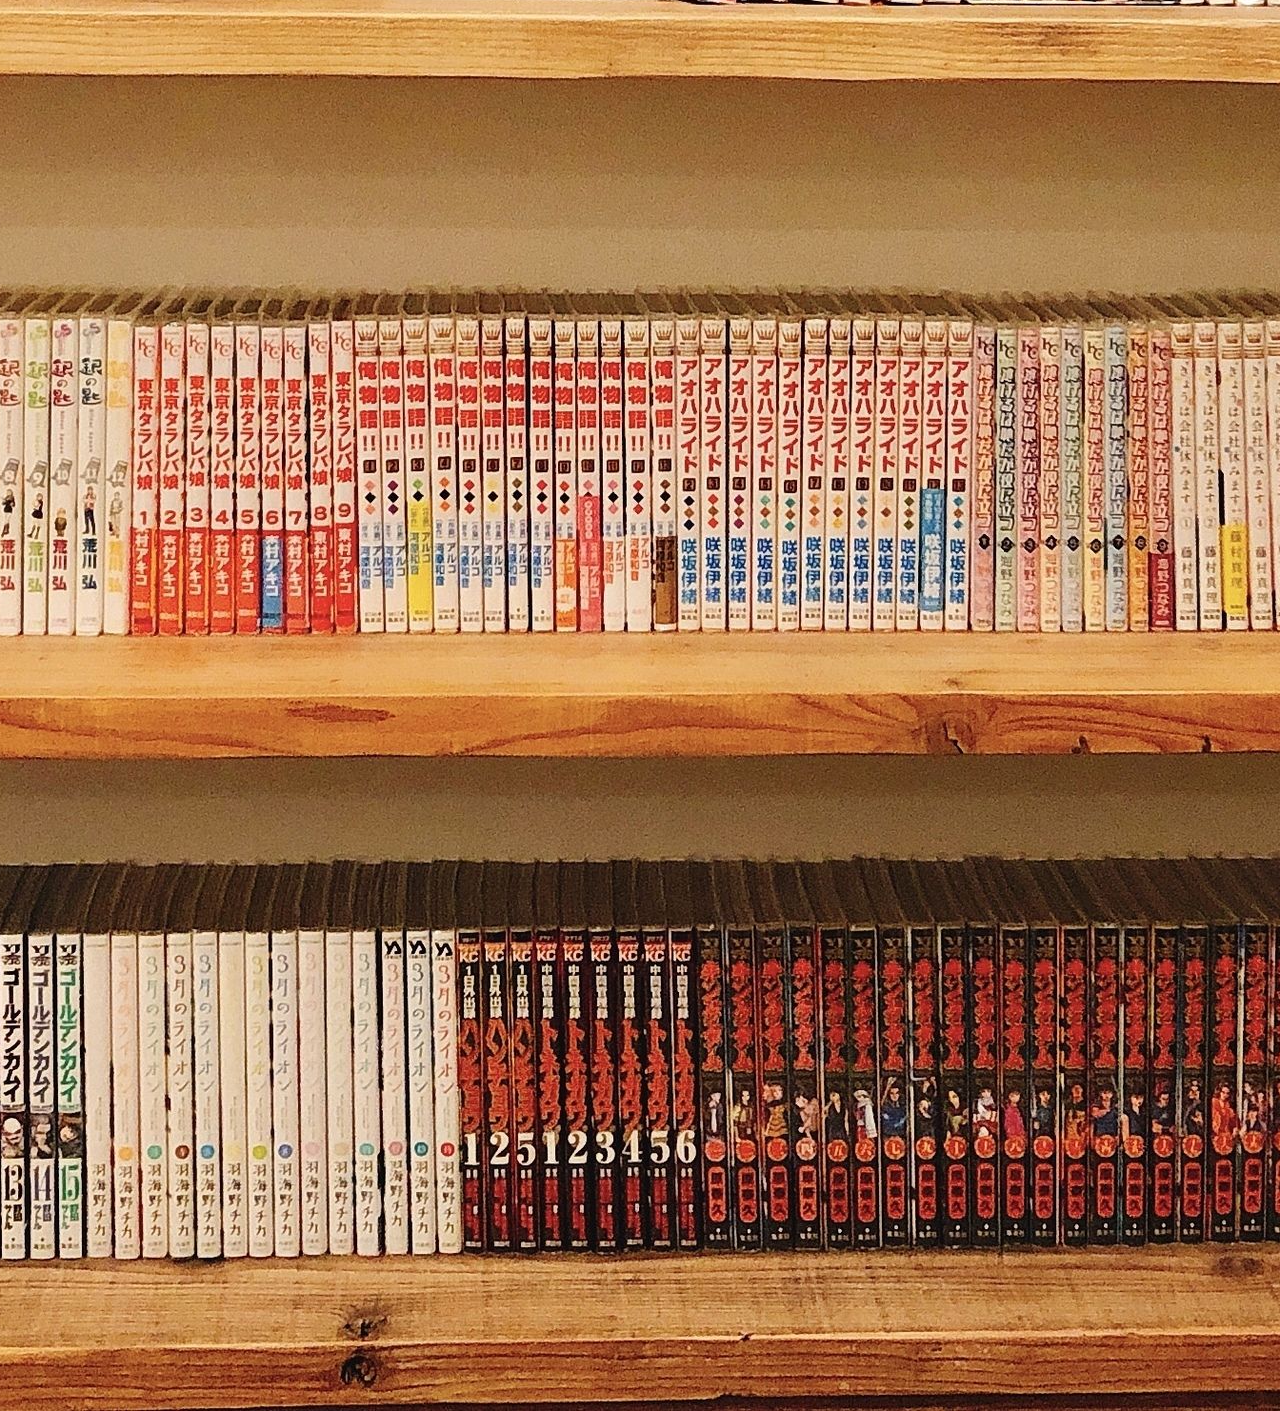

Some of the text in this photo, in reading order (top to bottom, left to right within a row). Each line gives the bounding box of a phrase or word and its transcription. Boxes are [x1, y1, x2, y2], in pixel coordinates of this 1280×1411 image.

[51, 358, 75, 408] 銀の匙
[358, 361, 379, 452] 俺物語!!
[433, 358, 455, 449] 俺物語!!
[532, 360, 552, 452] 俺物語!!
[680, 359, 699, 473] アオハライド
[704, 358, 723, 472] アオハライド
[756, 359, 775, 473] アオハライド
[137, 378, 156, 490] 東京タラレバ娘
[163, 378, 181, 490] 東京タラレバ娘
[214, 377, 232, 490] 東京タラレバ娘
[335, 371, 353, 483] 東京タラレバ娘
[337, 504, 351, 518] 9
[684, 480, 694, 490] 2
[708, 479, 718, 488] 3
[761, 479, 771, 489] 5
[140, 511, 148, 525] 1
[164, 511, 177, 526] 2
[215, 510, 229, 525] 4
[51, 539, 68, 591] 荒川弘
[680, 538, 698, 605] 咲坂伊緒
[704, 536, 722, 603] 咲坂伊緒
[757, 537, 774, 605] 咲坂伊緒
[172, 954, 190, 1092] 3月のライオン
[275, 954, 292, 1092] 3月のライオン
[463, 965, 477, 1019] 1日外出
[57, 970, 79, 1105] ゴールデンカムイ
[437, 964, 456, 1093] 3月のライオン
[464, 1133, 480, 1165] 1
[489, 1133, 510, 1165] 2
[517, 1133, 537, 1165] 5
[596, 1132, 616, 1164] 3
[676, 1129, 697, 1164] 6
[61, 1165, 80, 1201] 15
[174, 1164, 191, 1236] 羽海野チカ
[278, 1163, 295, 1235] 羽海野チカ
[439, 1161, 456, 1235] 羽海野チカ
